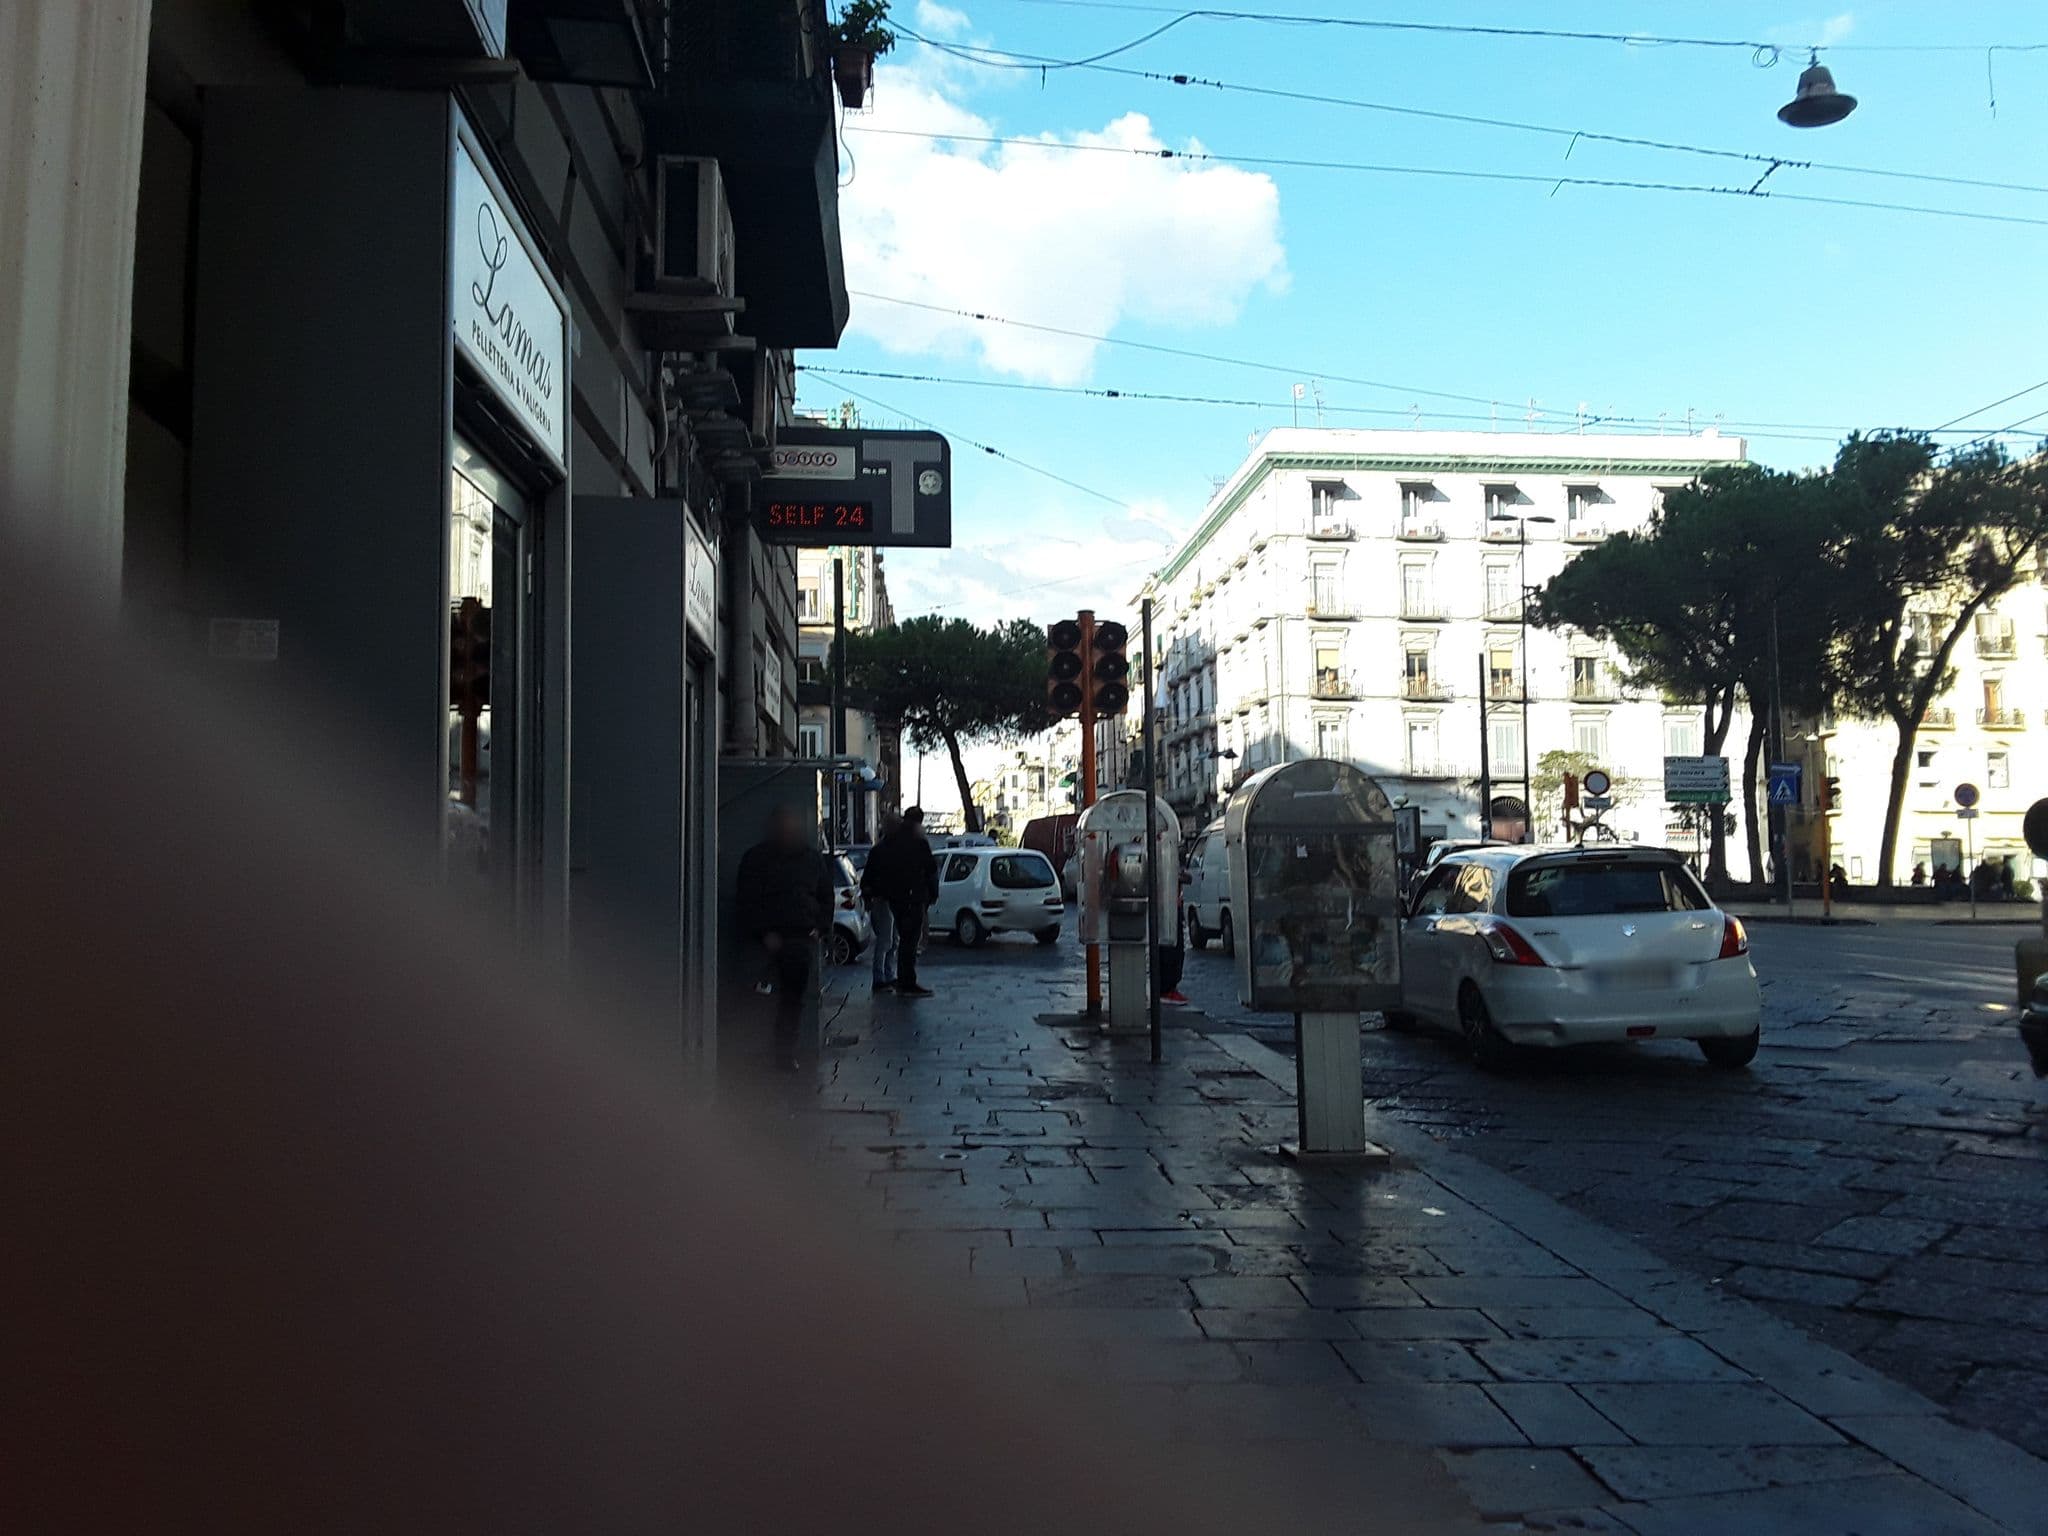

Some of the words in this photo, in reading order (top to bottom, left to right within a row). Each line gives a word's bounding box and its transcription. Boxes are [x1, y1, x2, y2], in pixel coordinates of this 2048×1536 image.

[472, 319, 515, 391] PELLETTERIA
[522, 384, 553, 437] VALIGERIA
[769, 503, 824, 526] SELF
[833, 505, 865, 526] 24
